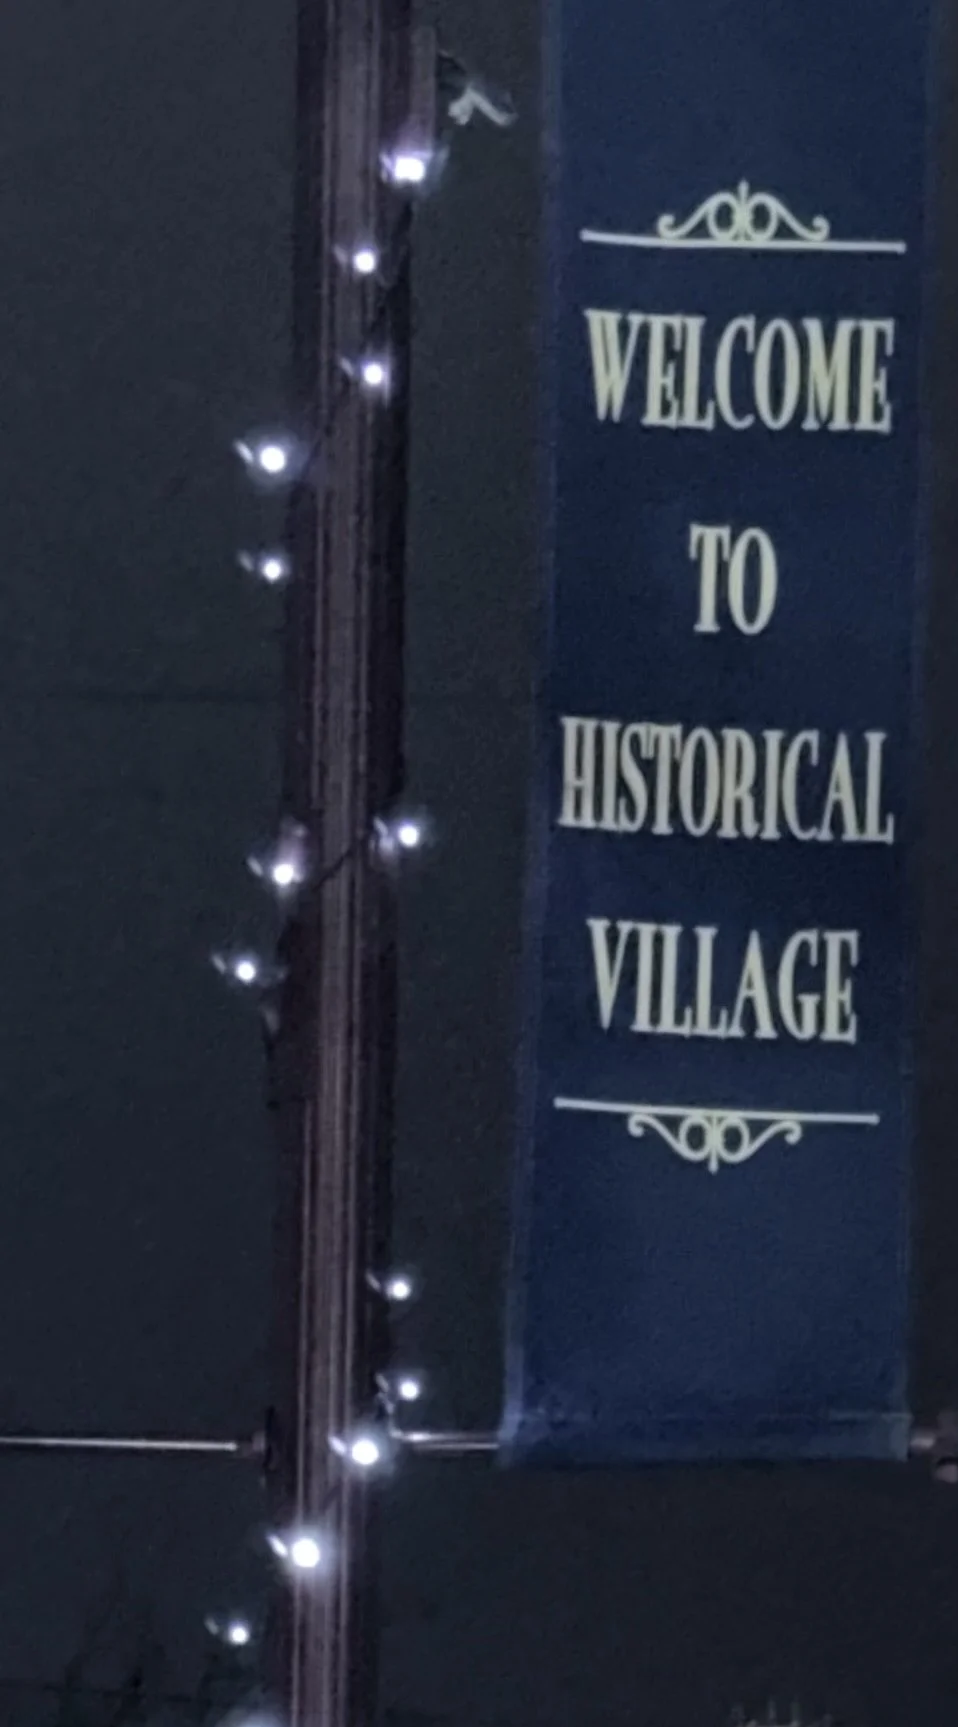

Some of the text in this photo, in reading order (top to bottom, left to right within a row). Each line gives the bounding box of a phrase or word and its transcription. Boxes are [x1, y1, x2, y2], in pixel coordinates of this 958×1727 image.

[584, 308, 895, 434] WELCOME
[689, 523, 778, 634] TO
[558, 715, 895, 845] HISTORICAL
[588, 917, 859, 1043] VILLAGE
